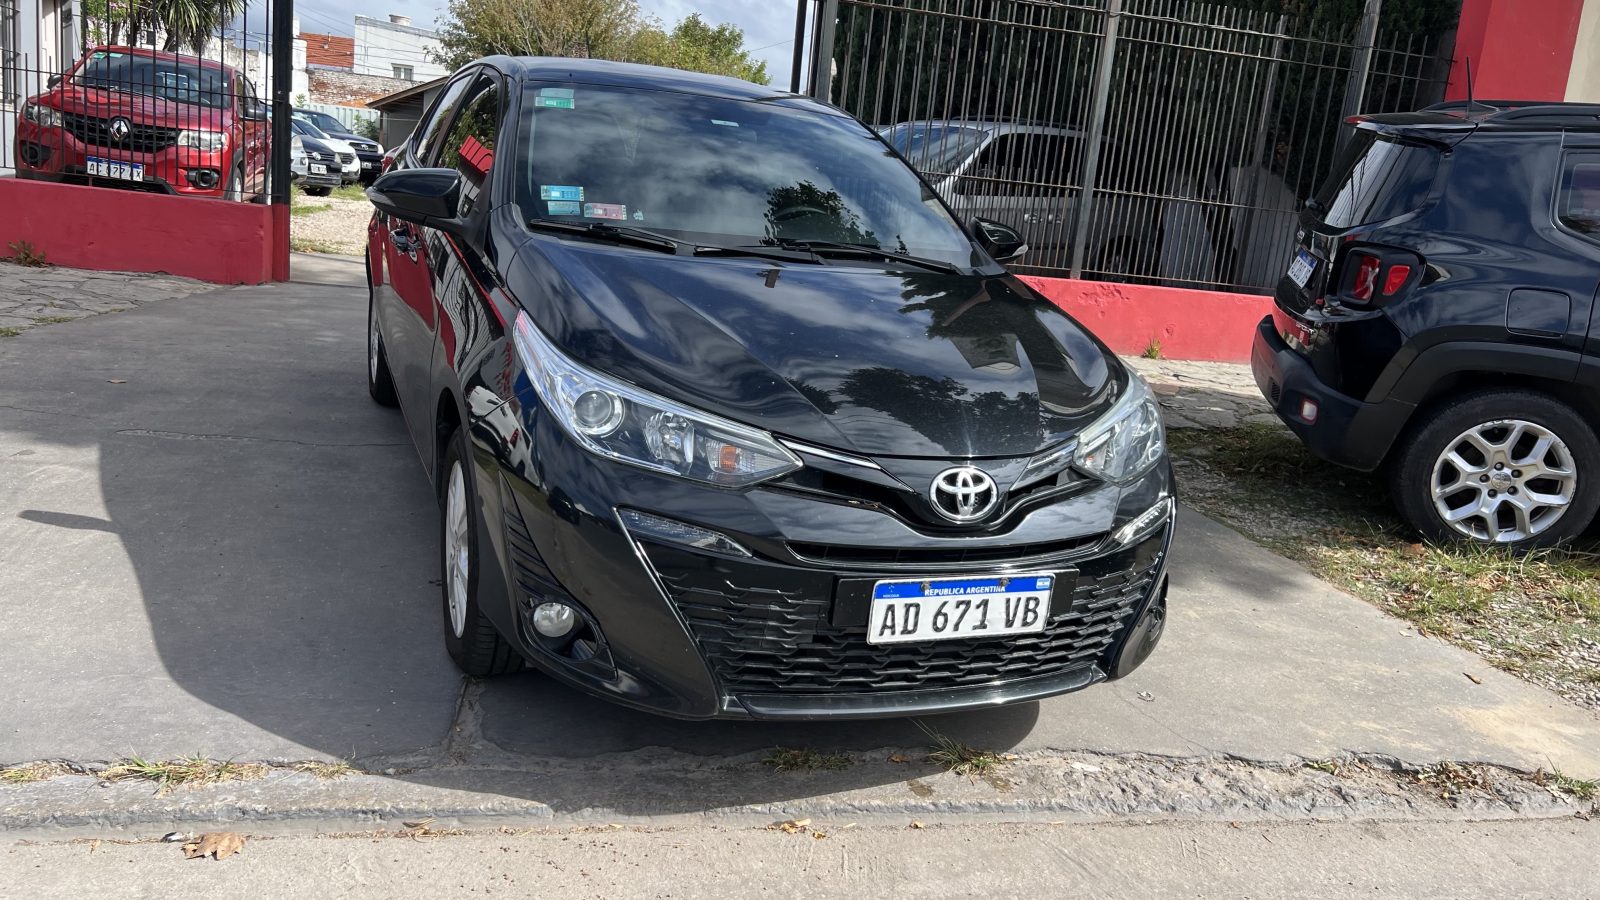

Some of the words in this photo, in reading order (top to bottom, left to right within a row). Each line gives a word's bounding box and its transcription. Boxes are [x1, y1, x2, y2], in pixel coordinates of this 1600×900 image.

[924, 587, 965, 597] REPUBLICA
[966, 585, 1006, 594] ARGENTINA
[878, 602, 921, 637] AD
[932, 598, 990, 633] 671
[1004, 595, 1040, 629] VB
